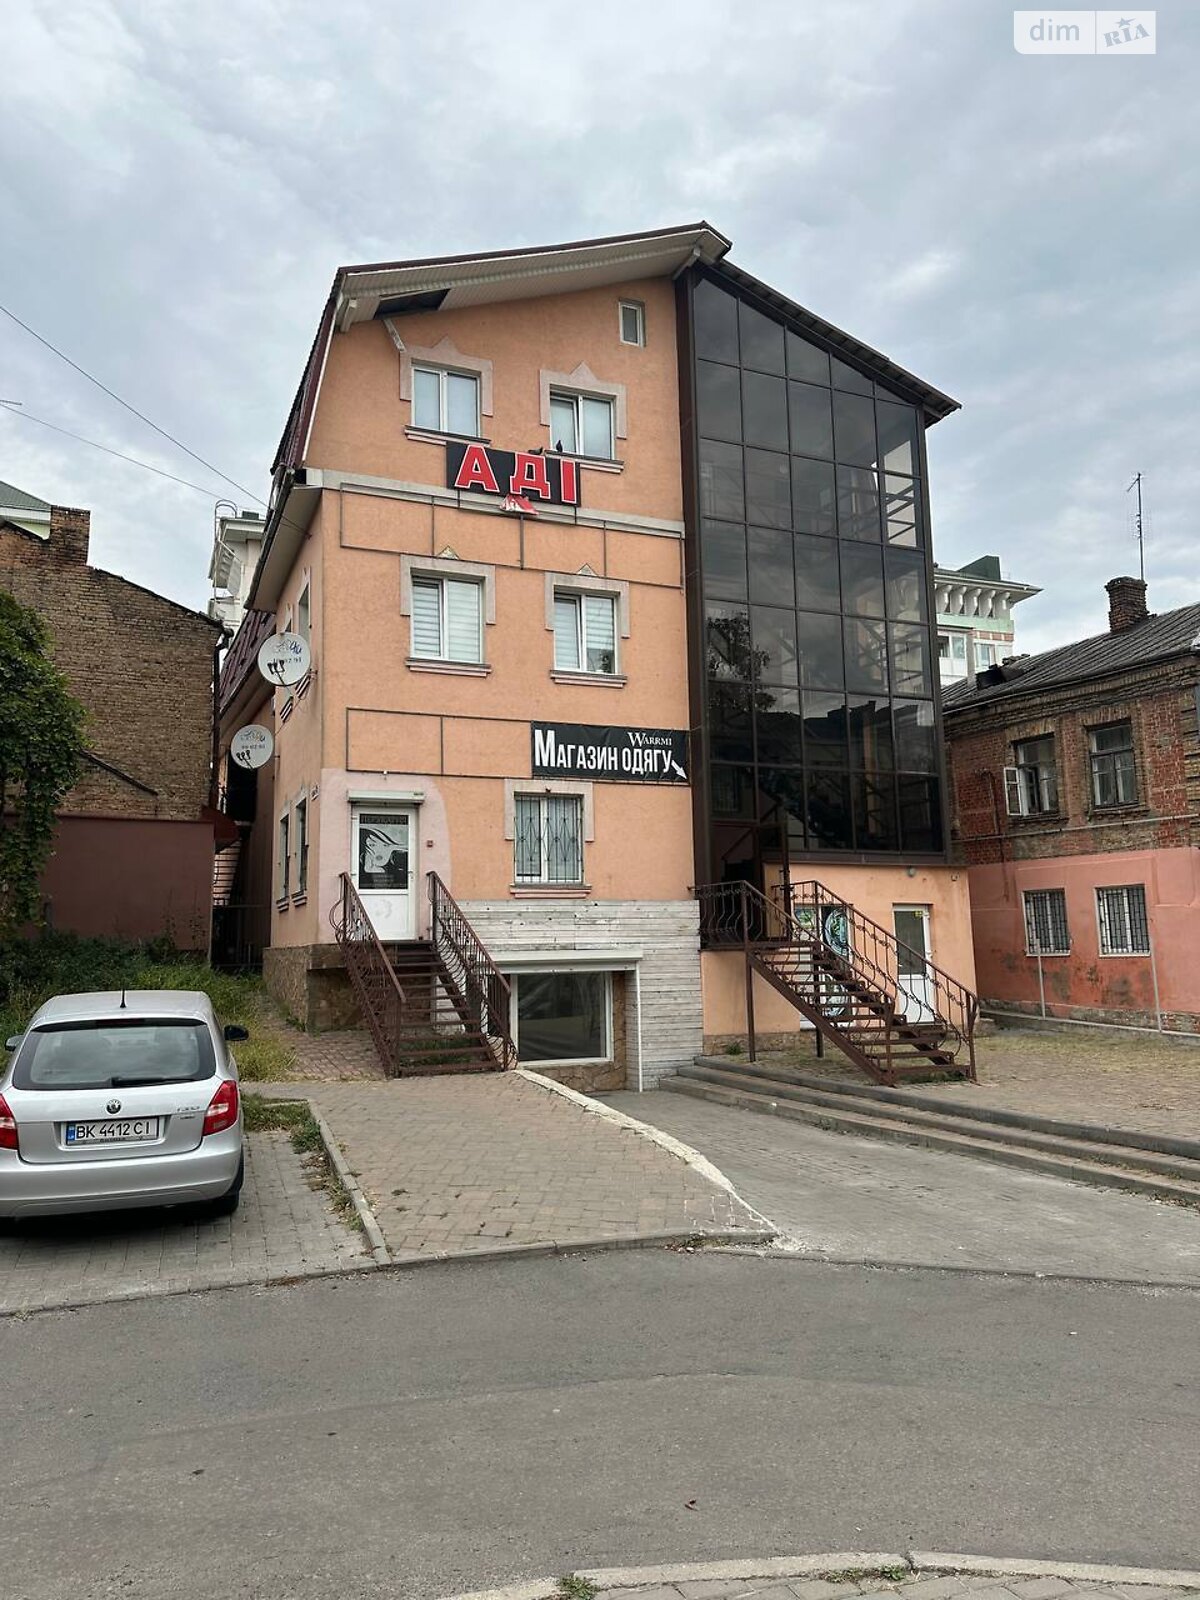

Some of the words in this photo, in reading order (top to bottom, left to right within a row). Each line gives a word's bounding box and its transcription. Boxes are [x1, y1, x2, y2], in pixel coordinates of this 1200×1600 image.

[534, 729, 618, 771] МАГАЗИН
[622, 747, 672, 775] ОДЯГУ
[76, 1124, 96, 1139] BK
[100, 1123, 130, 1137] 4412
[134, 1121, 150, 1134] CI
